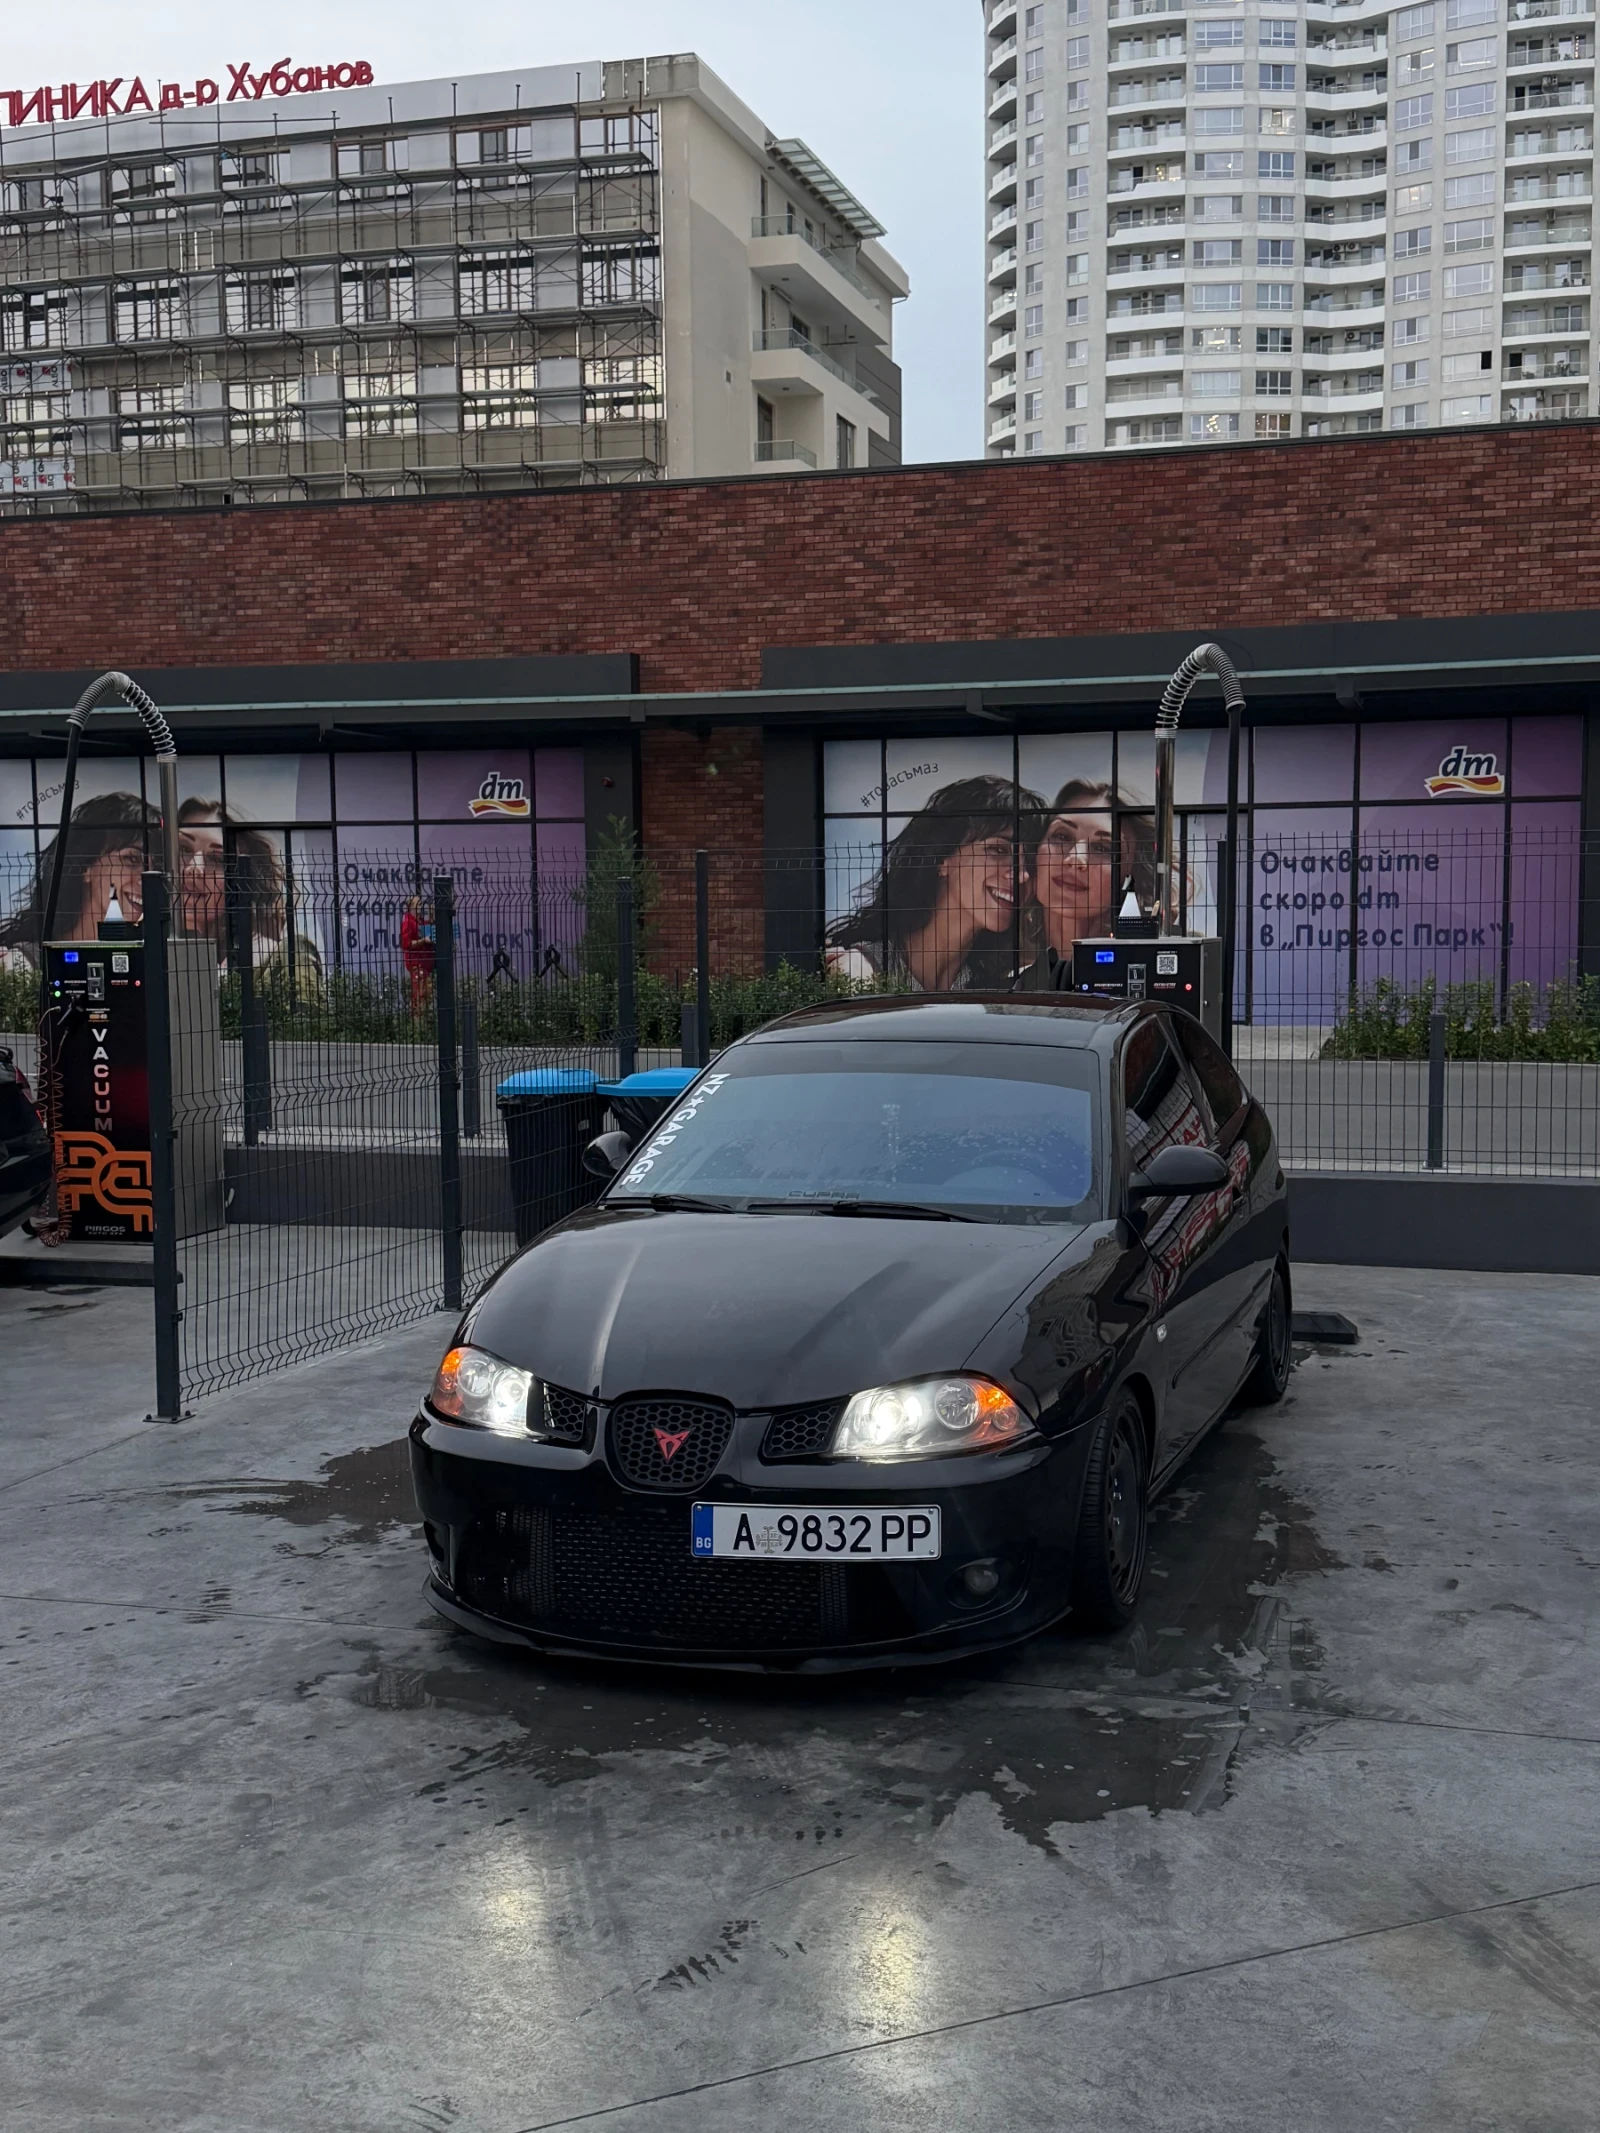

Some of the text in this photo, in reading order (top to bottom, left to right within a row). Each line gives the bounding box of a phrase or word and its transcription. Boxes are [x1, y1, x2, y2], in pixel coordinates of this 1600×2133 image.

[159, 79, 218, 110] д-р
[226, 57, 374, 101] Хубанов
[1441, 748, 1495, 778] dm
[16, 780, 80, 820] #тоасъмз
[481, 774, 522, 800] dm
[1260, 849, 1440, 874] Очаквайте
[1259, 885, 1400, 916] скоро dm
[92, 1028, 113, 1132] VACUUM
[621, 1073, 731, 1186] NZ GARAGE
[788, 1190, 860, 1200] CUPRA
[85, 1225, 126, 1233] PIRGOS
[696, 1537, 712, 1549] BG
[733, 1513, 756, 1551] A
[777, 1514, 872, 1553] 9832
[881, 1515, 931, 1553] PP
